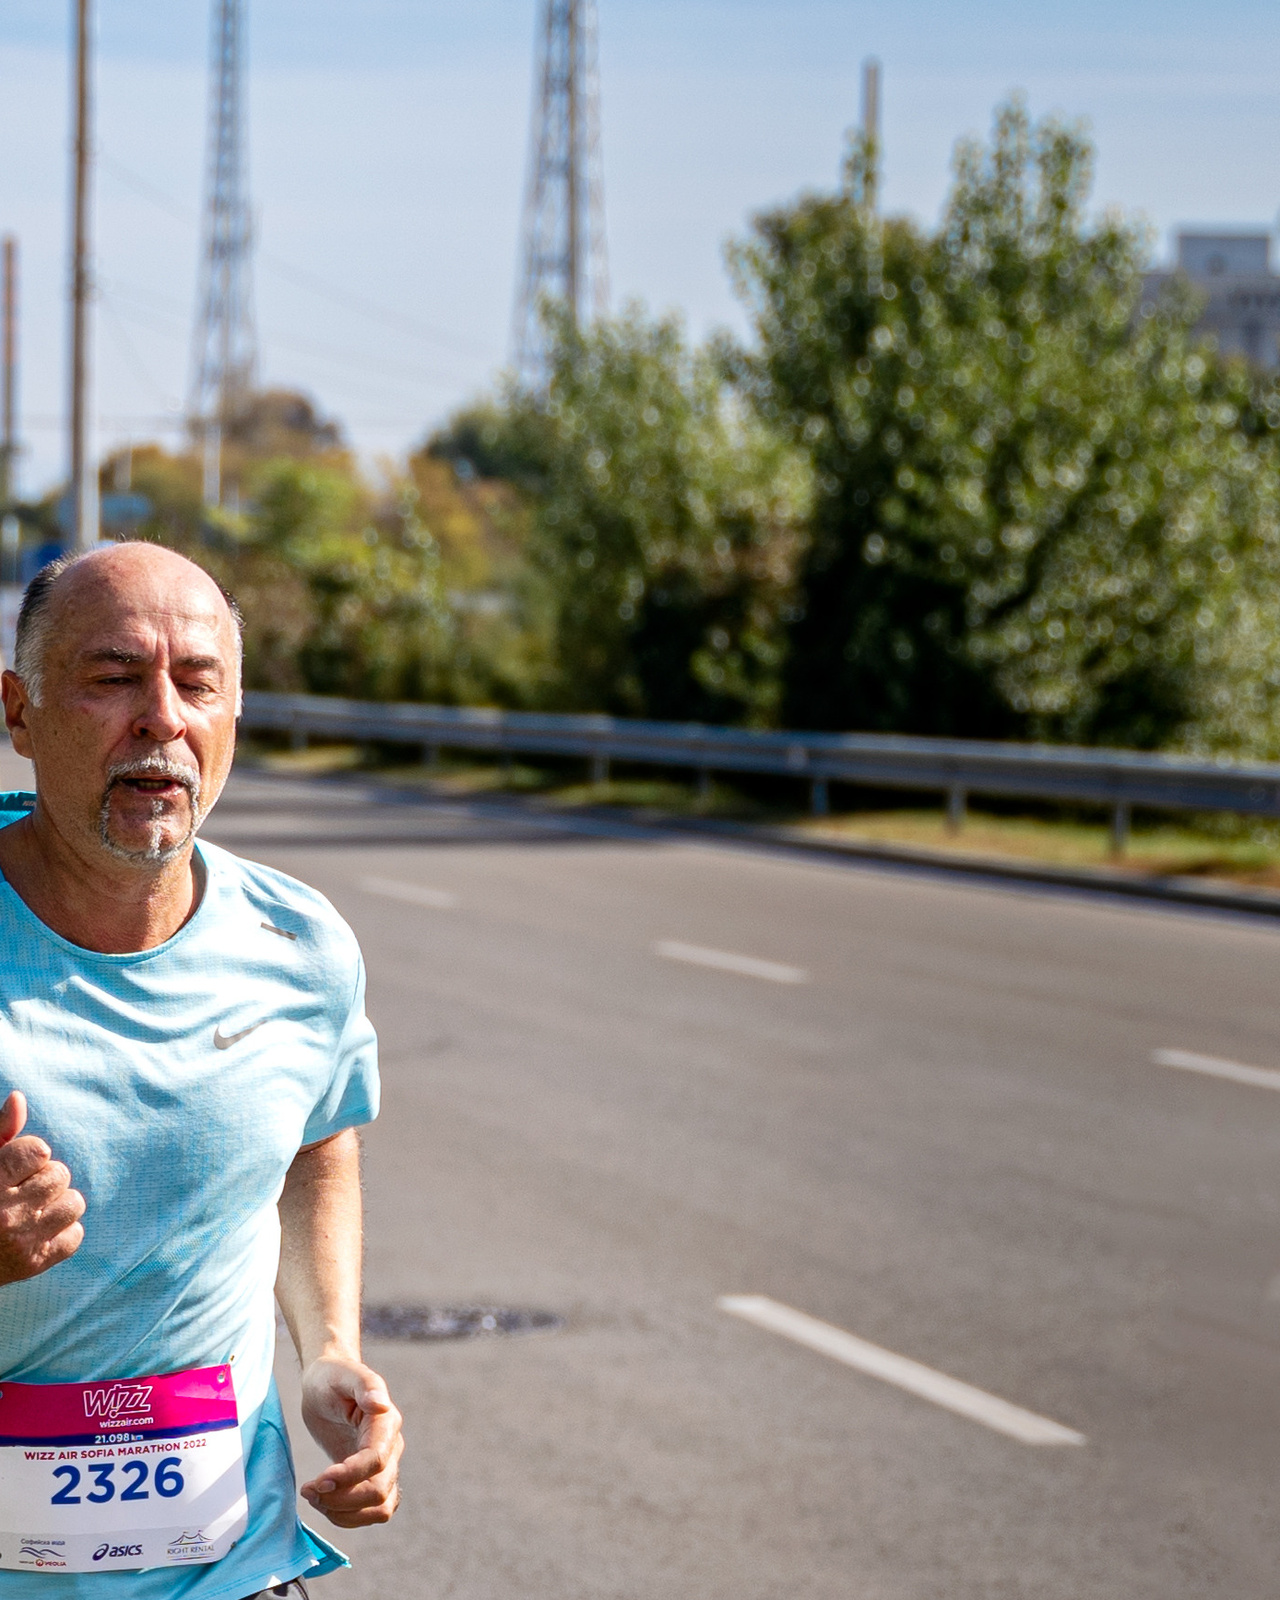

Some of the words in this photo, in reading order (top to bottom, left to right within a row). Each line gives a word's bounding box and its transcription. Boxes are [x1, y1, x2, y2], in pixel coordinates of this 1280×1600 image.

[99, 1416, 154, 1428] wizzair.com
[94, 1432, 130, 1444] 21.098
[24, 1451, 56, 1461] WIZZ
[57, 1450, 78, 1460] AIR
[80, 1447, 116, 1459] SOFIA
[117, 1441, 181, 1457] MARATHON
[183, 1438, 208, 1450] 2022
[50, 1456, 185, 1505] 2326
[167, 1547, 189, 1556] RIGHT
[190, 1544, 215, 1554] RENTAL
